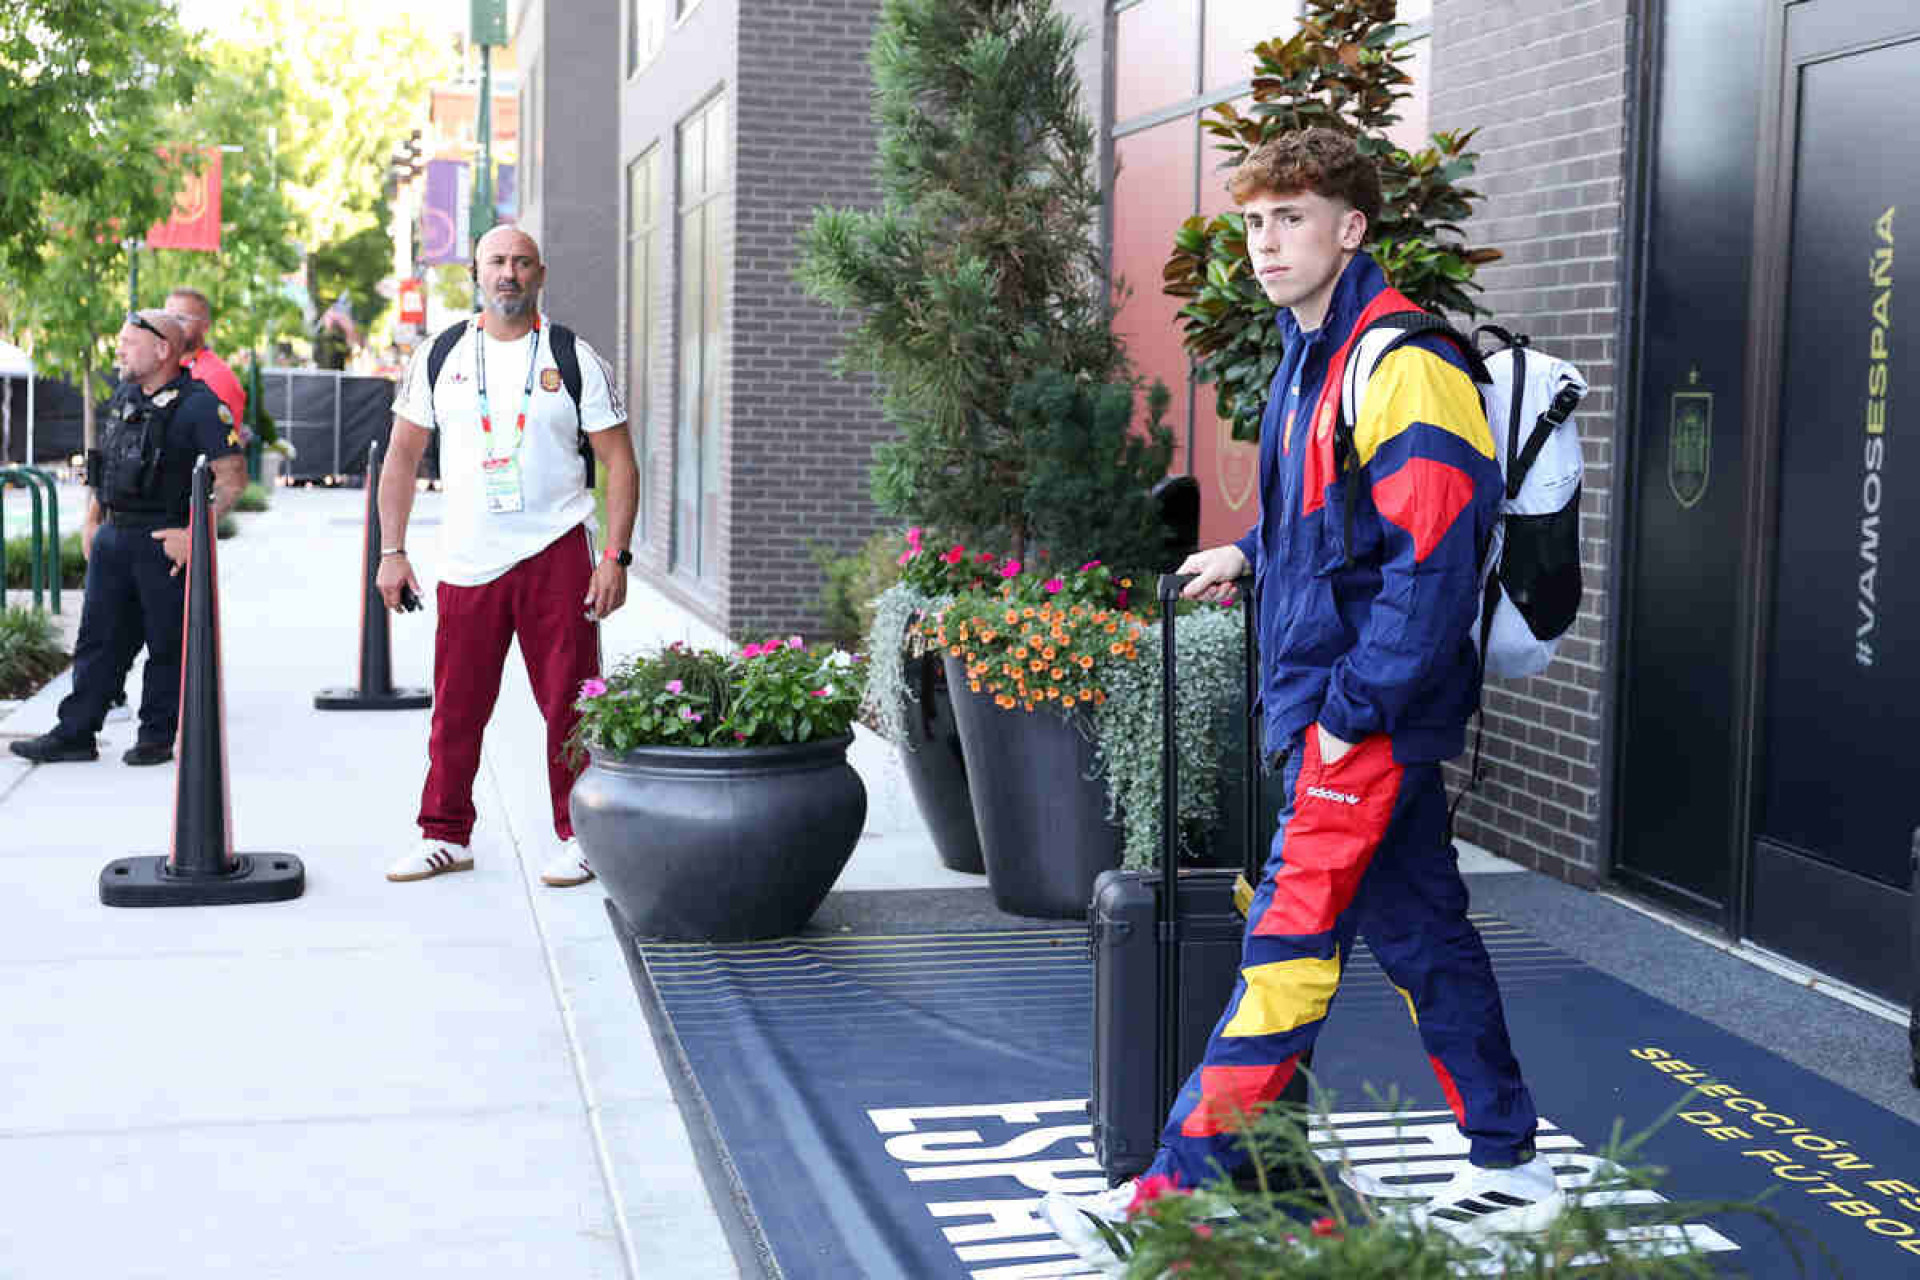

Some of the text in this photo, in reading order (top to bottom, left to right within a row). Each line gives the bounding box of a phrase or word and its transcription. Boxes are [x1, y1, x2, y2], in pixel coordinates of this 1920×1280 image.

[1856, 204, 1896, 667] #VAMOSESPAÑA
[1306, 786, 1344, 802] adidas
[1629, 1047, 1875, 1170] SELECCIÓN
[1677, 1110, 1754, 1140] DE
